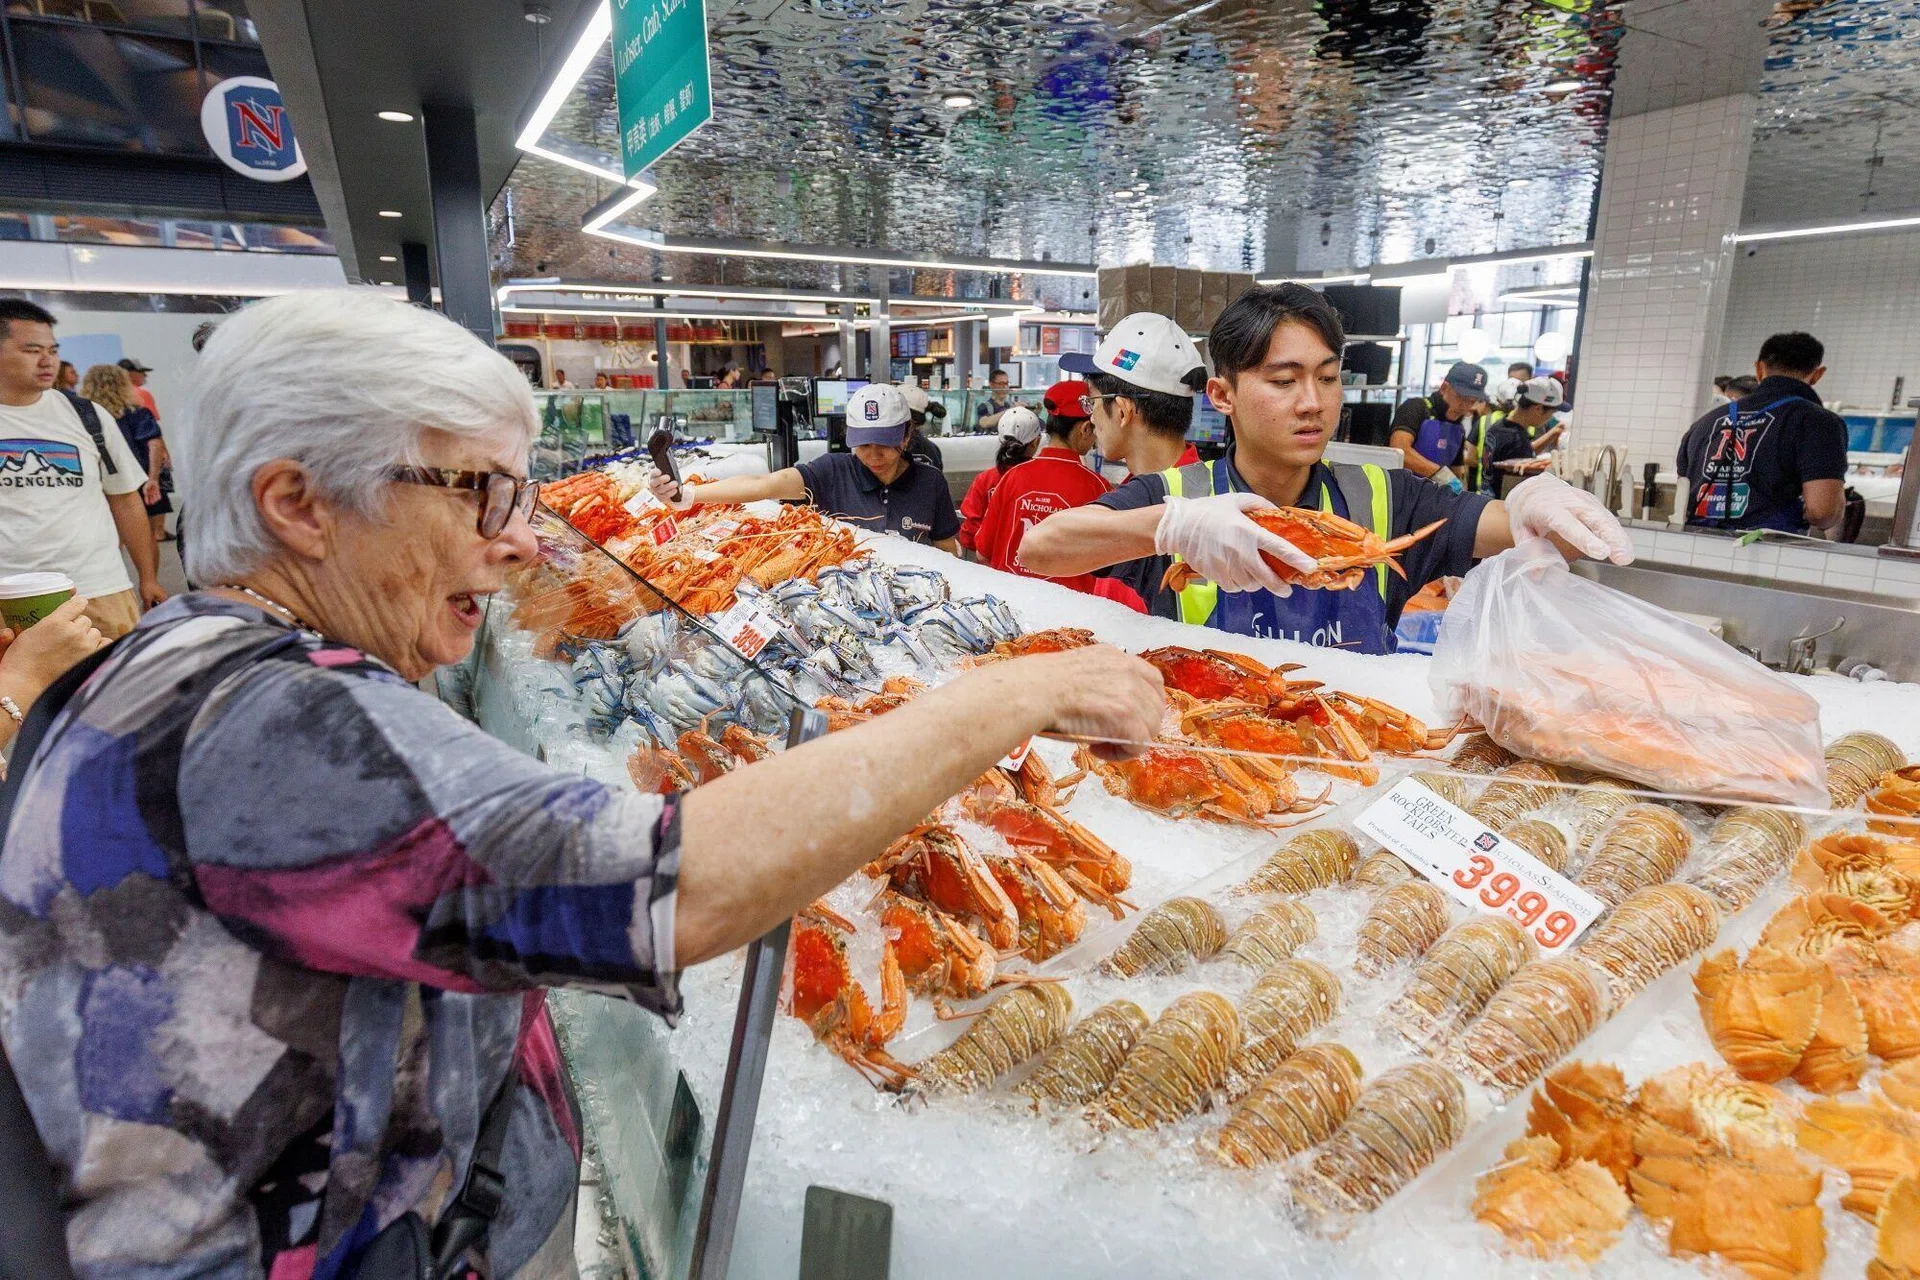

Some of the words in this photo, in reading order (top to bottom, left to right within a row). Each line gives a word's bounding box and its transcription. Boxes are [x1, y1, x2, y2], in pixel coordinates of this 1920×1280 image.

[232, 101, 285, 151] N
[1416, 796, 1456, 825] GREEN
[1402, 812, 1438, 840] TAILS
